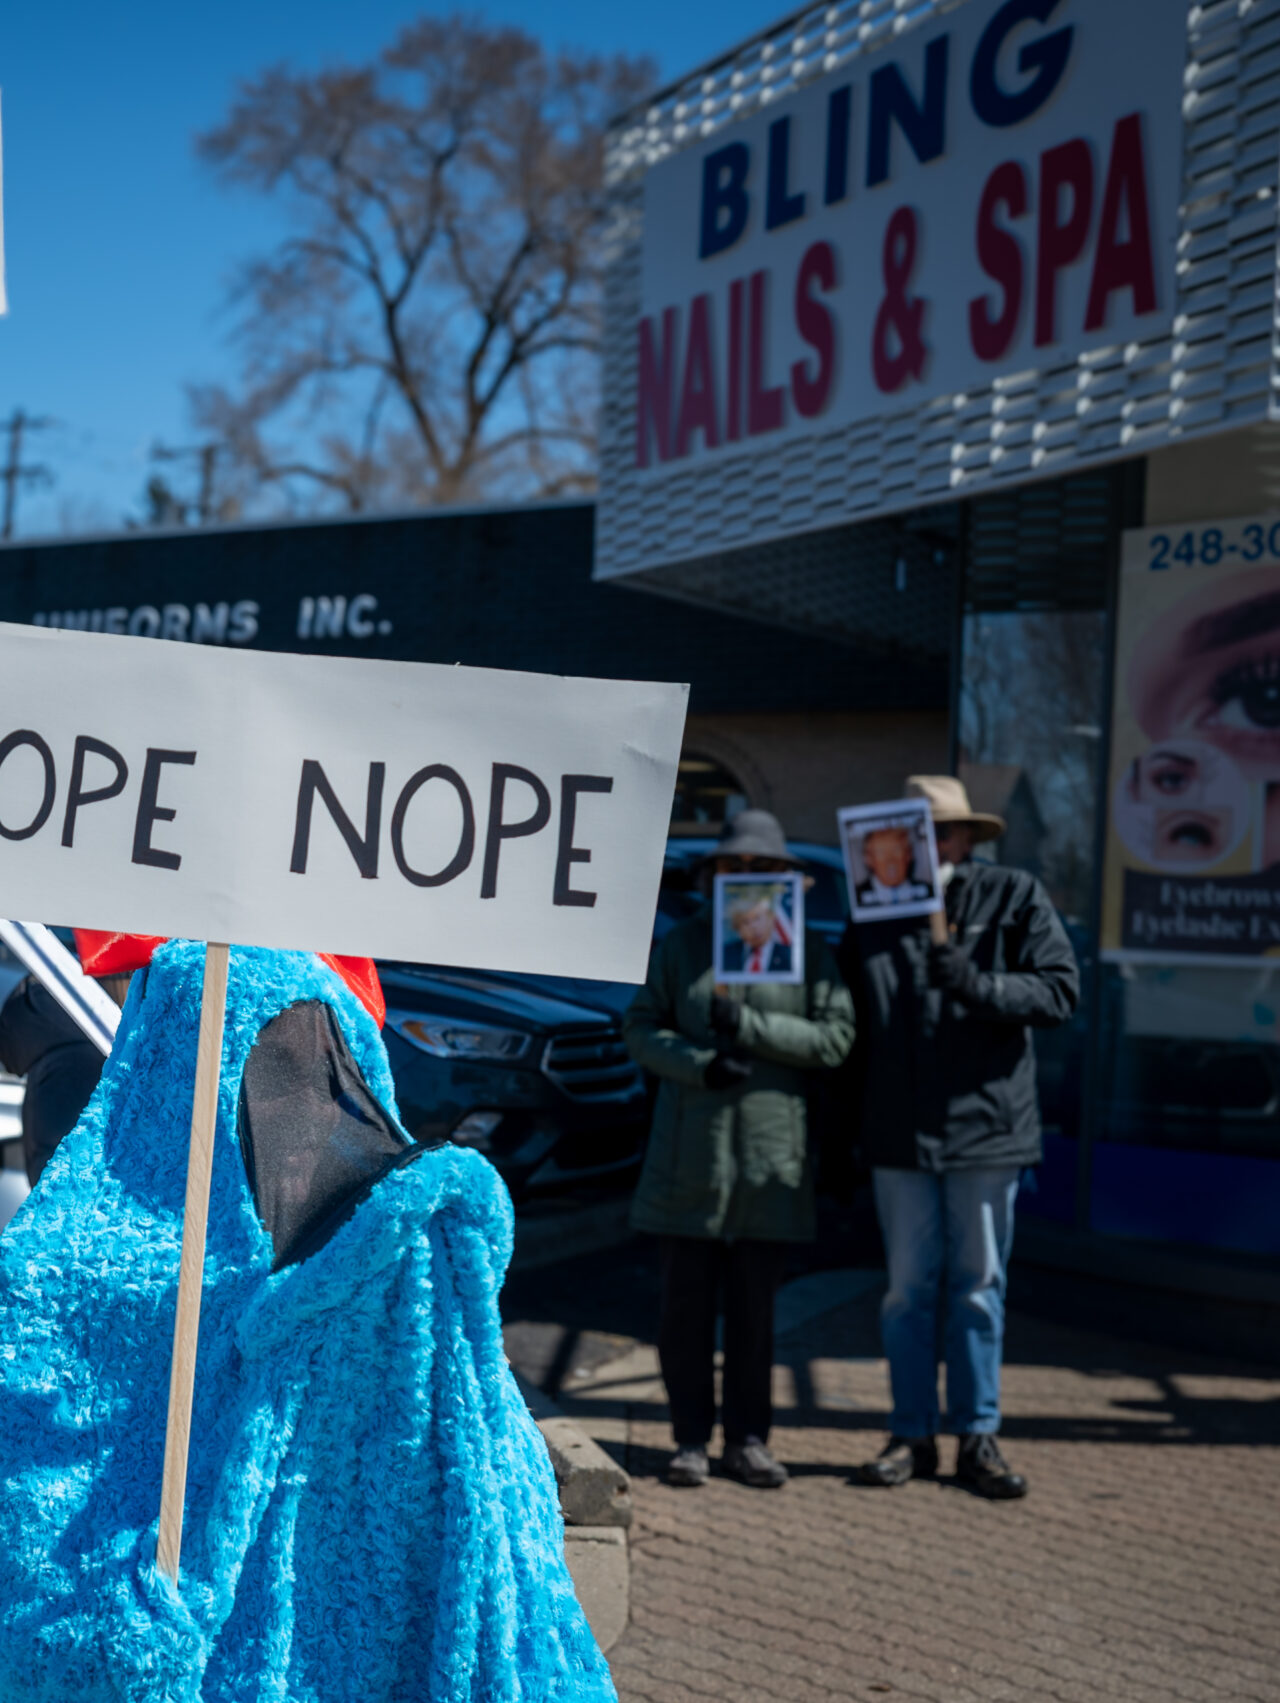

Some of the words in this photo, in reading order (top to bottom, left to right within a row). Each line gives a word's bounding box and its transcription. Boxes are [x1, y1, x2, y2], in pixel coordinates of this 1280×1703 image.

[698, 0, 1080, 262] BLING
[634, 240, 838, 470] NAILS
[871, 205, 929, 395] &
[969, 112, 1159, 363] SPA
[296, 593, 394, 640] INC.
[289, 759, 615, 909] NOPE
